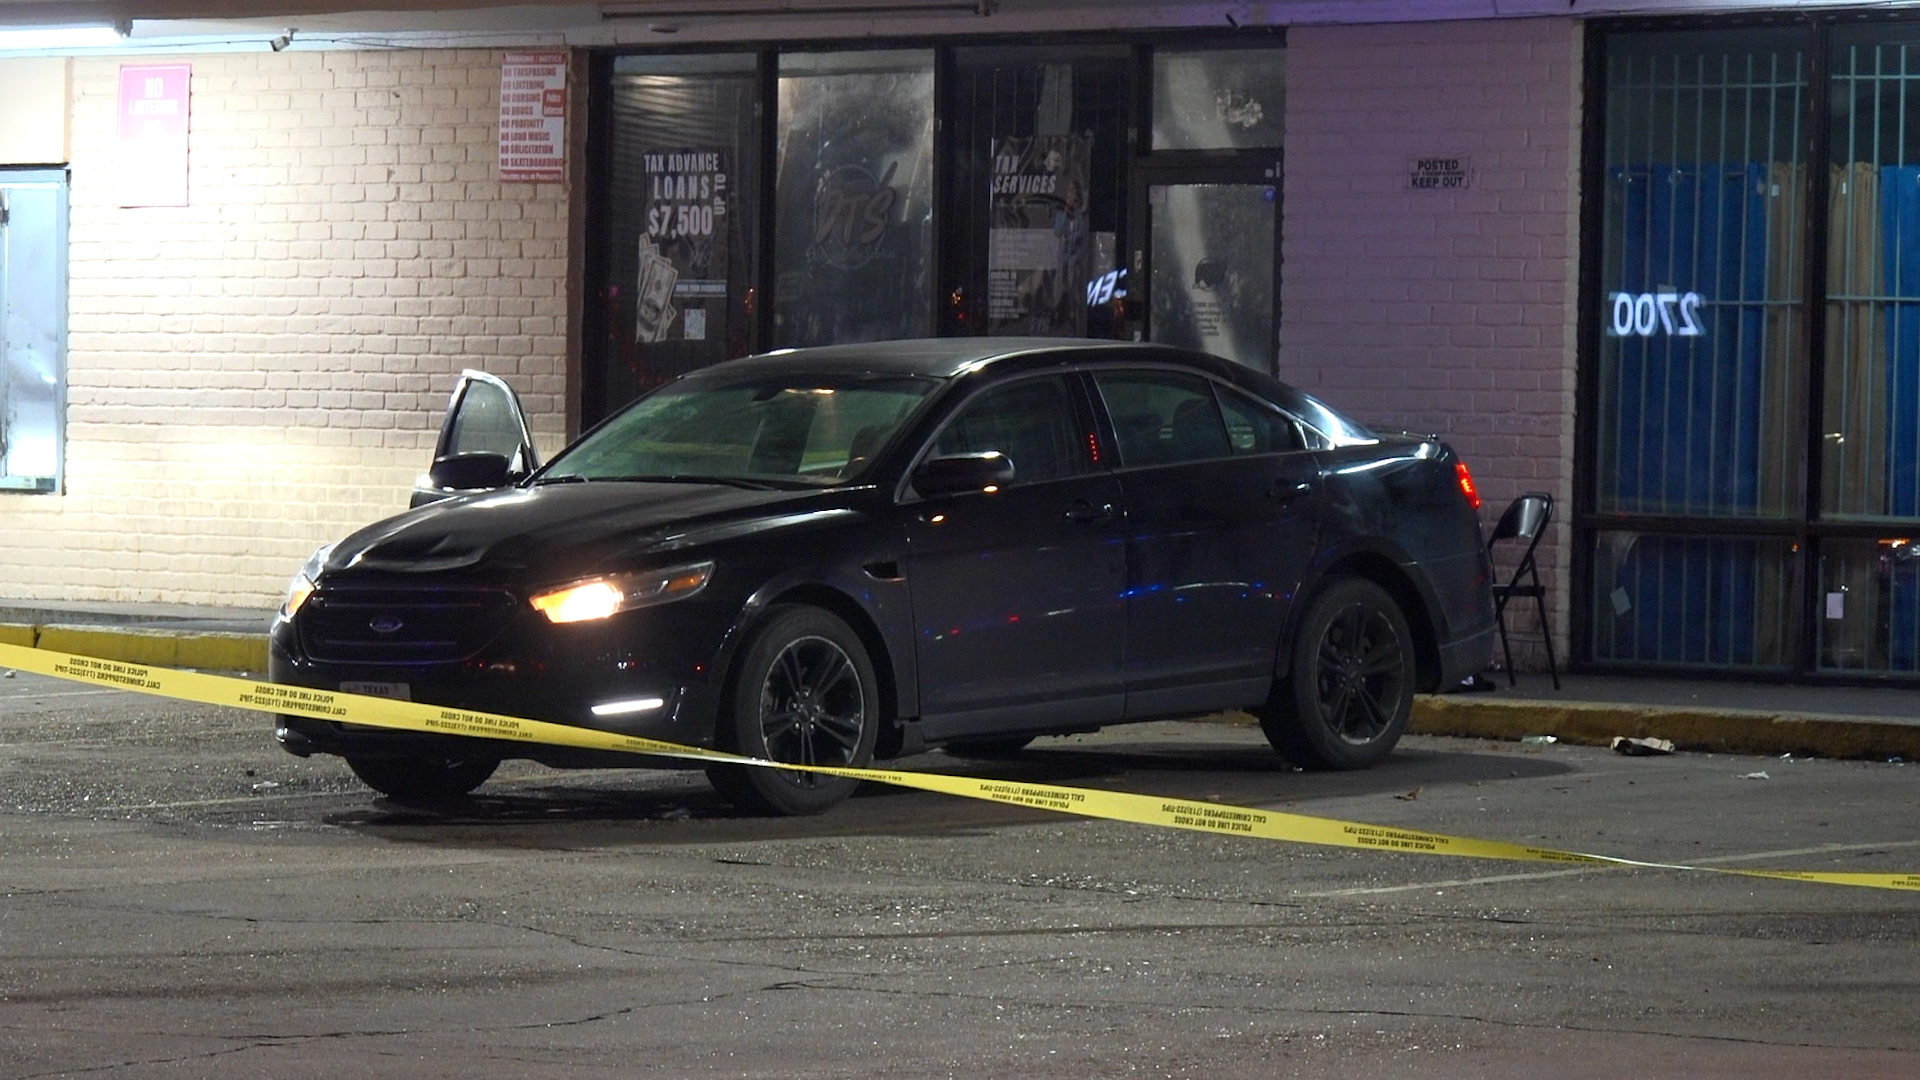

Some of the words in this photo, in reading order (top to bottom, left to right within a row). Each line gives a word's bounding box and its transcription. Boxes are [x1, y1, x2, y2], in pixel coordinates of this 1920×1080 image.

[503, 68, 512, 76] NO
[513, 67, 556, 76] TRESPASSING
[145, 77, 163, 98] NO
[503, 81, 511, 89] NO
[512, 80, 545, 89] LOITERING
[502, 93, 511, 102] NO
[512, 93, 541, 102] CURSING
[128, 98, 178, 114] LOITERING
[502, 106, 510, 115] NO
[511, 106, 534, 115] DRUGS
[501, 119, 510, 128] NO
[501, 132, 509, 141] NO
[510, 132, 527, 141] LOUD
[528, 132, 550, 141] MUSIC
[500, 145, 509, 154] NO
[510, 145, 554, 154] SOLICITATION
[501, 158, 509, 167] NO
[644, 154, 664, 173] TAX
[668, 153, 718, 172] ADVANCE
[994, 155, 1019, 174] TAX
[1418, 160, 1459, 171] POSTED
[714, 174, 726, 190] TO
[993, 175, 1056, 195] SERVICES
[1411, 177, 1439, 188] KEEP
[1442, 176, 1464, 187] OUT
[654, 176, 710, 200] LOANS
[714, 196, 726, 216] UP
[648, 205, 713, 240] $7,500
[362, 684, 390, 694] TEXAS
[1049, 801, 1069, 809] POLICE
[1174, 816, 1193, 825] CROSS
[1208, 820, 1215, 828] DO
[1217, 821, 1230, 829] LINE
[1232, 823, 1252, 832] POLICE
